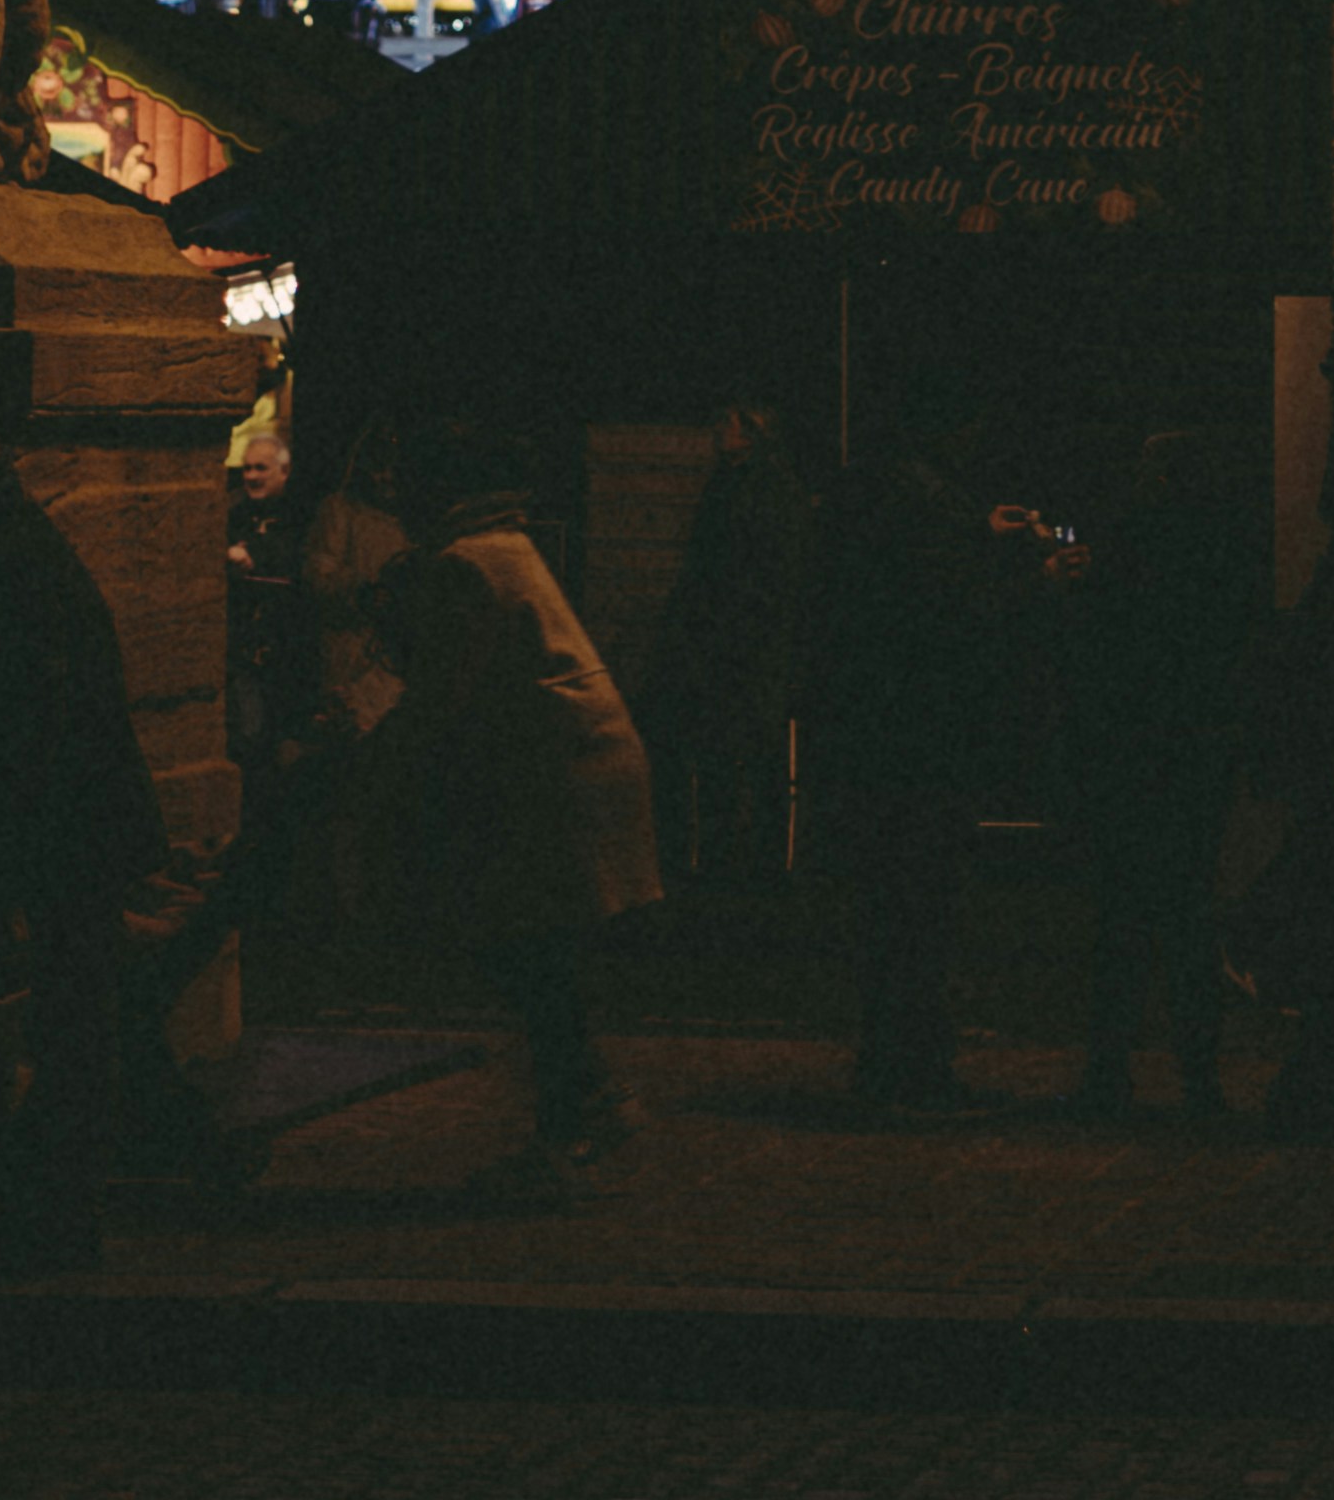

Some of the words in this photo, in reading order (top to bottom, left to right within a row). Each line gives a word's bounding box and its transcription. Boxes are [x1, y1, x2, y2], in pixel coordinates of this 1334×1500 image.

[770, 45, 919, 100] Crêpes
[967, 43, 1157, 102] Beignets
[751, 104, 919, 162] Réglisse
[948, 102, 1165, 160] Américain
[827, 160, 963, 216] Candy
[985, 159, 1089, 206] Cane
